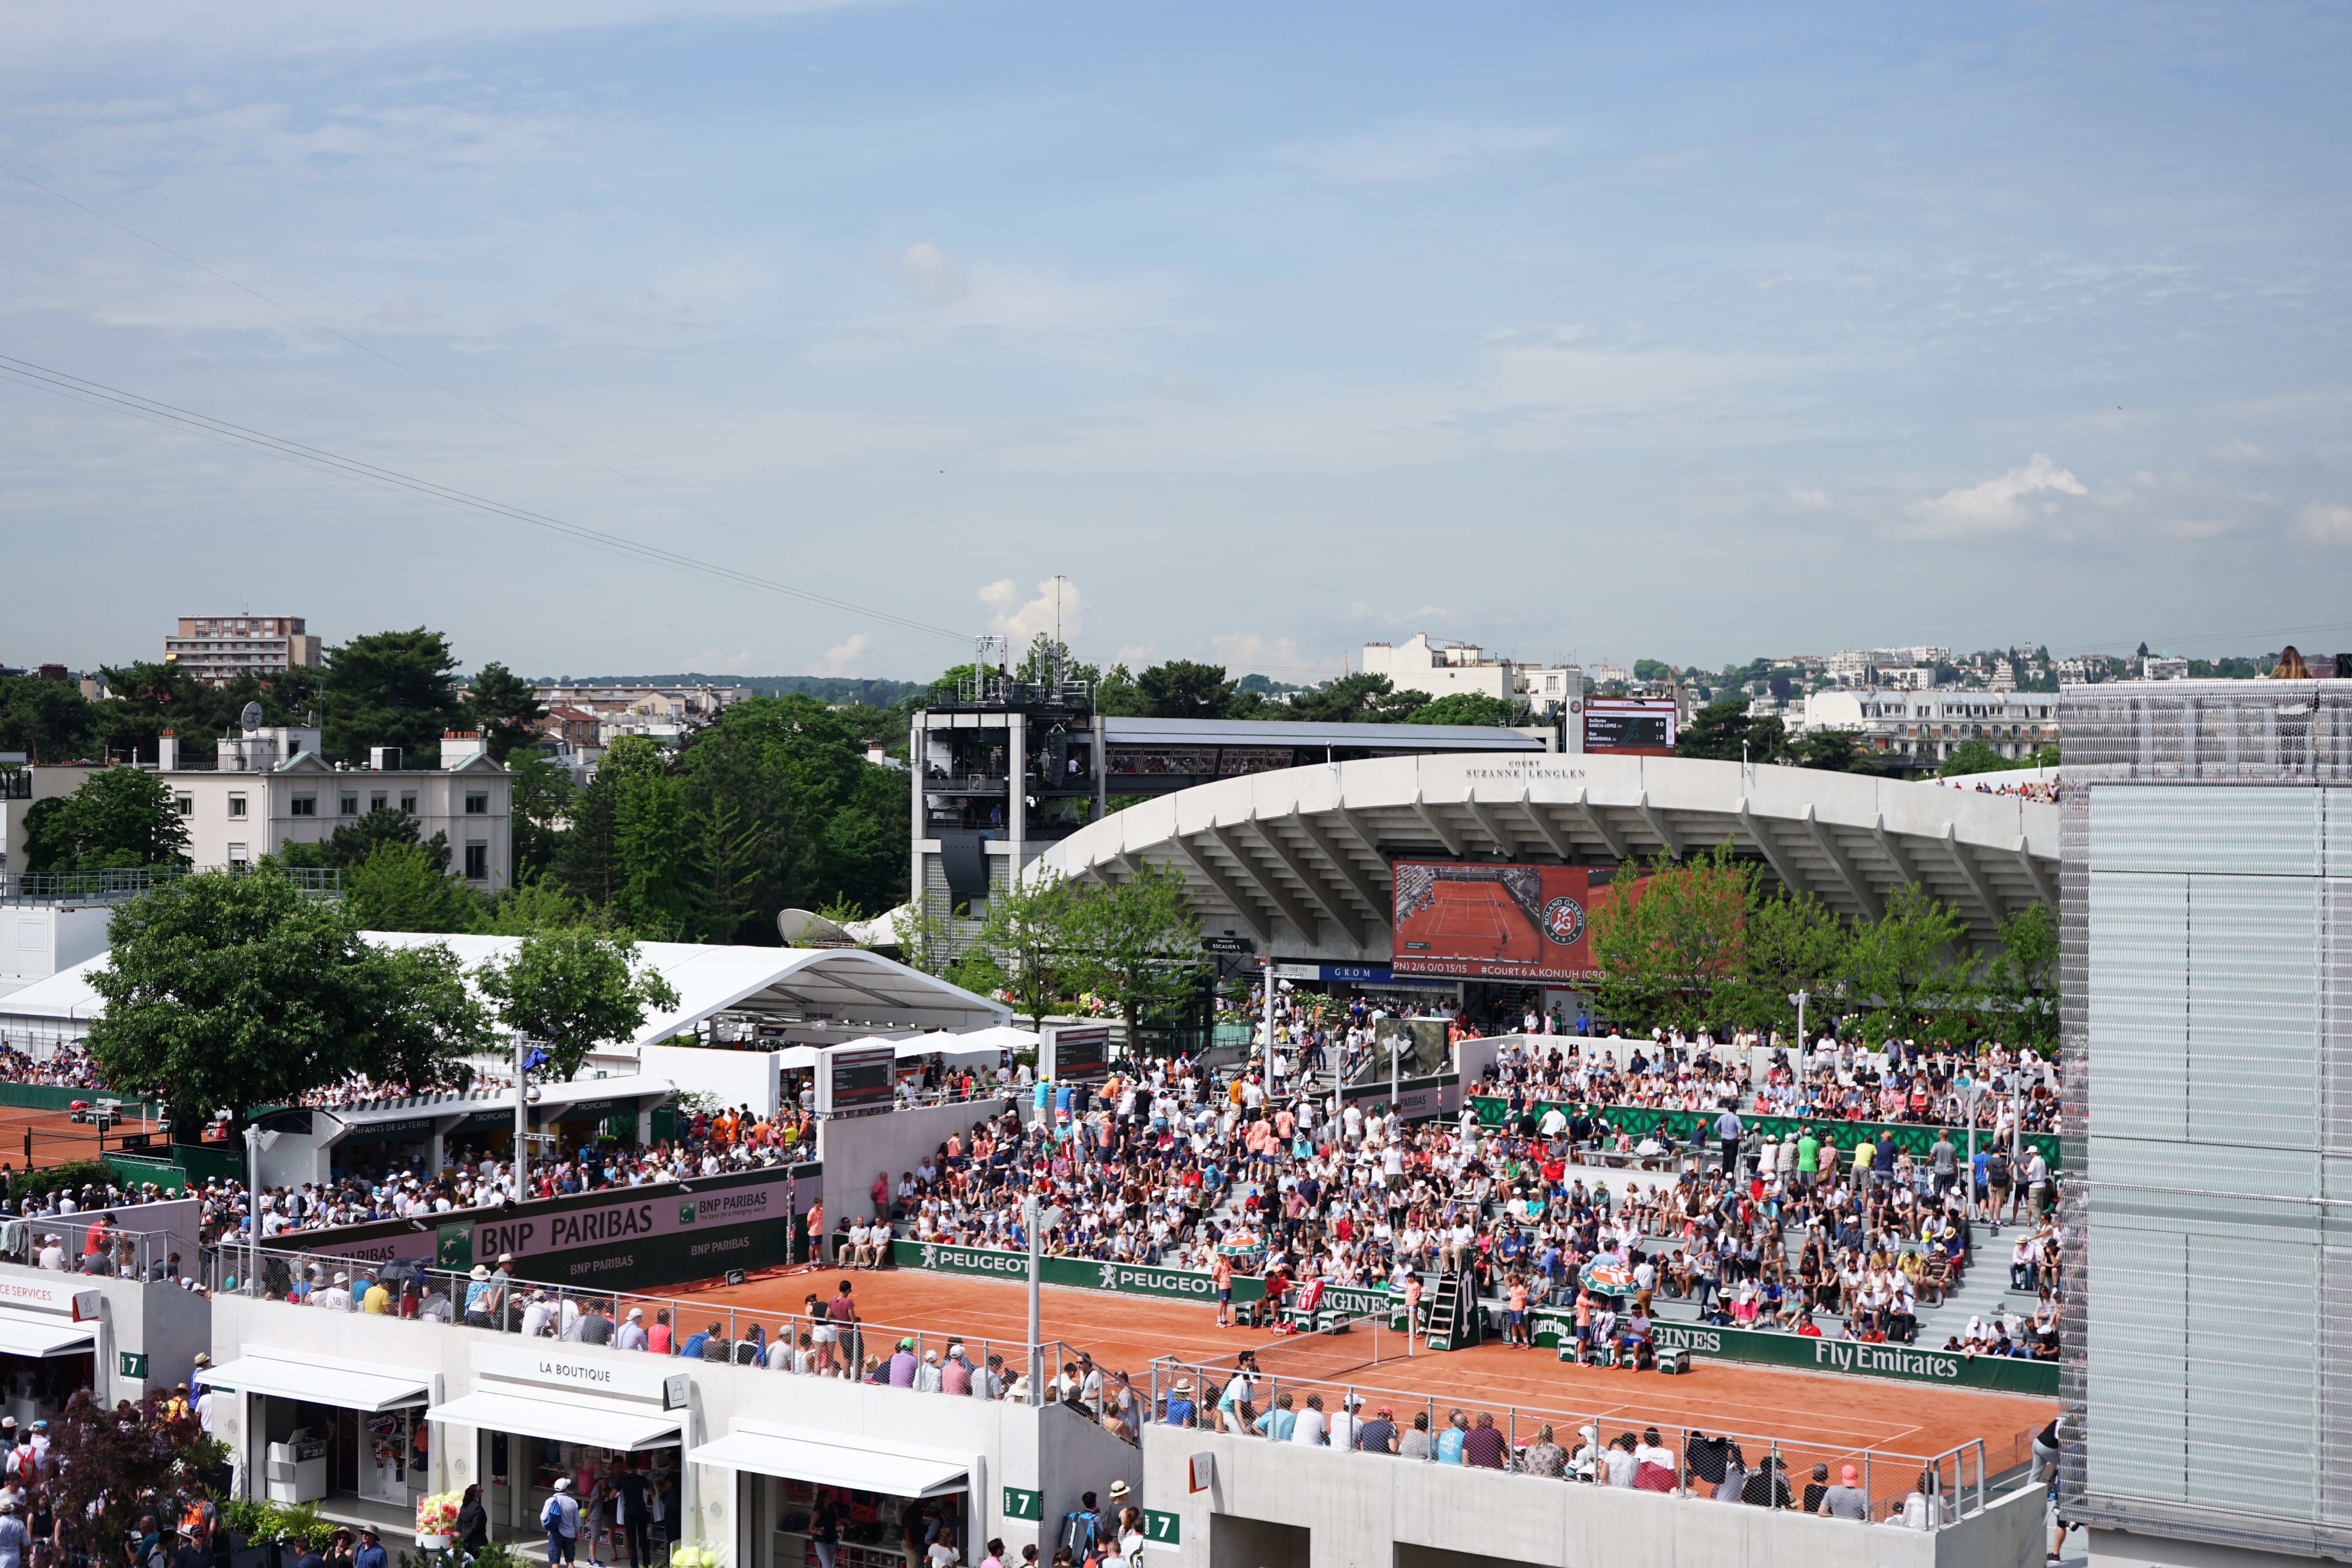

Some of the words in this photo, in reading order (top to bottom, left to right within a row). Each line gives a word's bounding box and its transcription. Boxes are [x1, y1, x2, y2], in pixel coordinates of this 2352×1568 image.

[1466, 769, 1520, 779] SUZANNE
[1529, 769, 1586, 779] LENGLEN
[1544, 899, 1563, 926] ROLAND
[1564, 899, 1583, 927] GARROS
[1550, 932, 1576, 942] PARIS
[1412, 963, 1425, 971] 2/6
[1427, 964, 1444, 972] 0/0
[1446, 964, 1467, 973] 15/15
[1481, 965, 1519, 976] #COURT
[1522, 967, 1527, 976] 6
[1529, 968, 1579, 978] A.KONJUH
[578, 1101, 612, 1111] TROPICANA
[1400, 1095, 1426, 1107] PARIBAS
[102, 1122, 106, 1130] 8
[475, 1112, 511, 1122] TROPICANA
[351, 1124, 384, 1135] ENFANTS
[408, 1120, 430, 1129] TERRE
[699, 1198, 721, 1214] BNP
[724, 1192, 767, 1210] PARIBAS
[482, 1223, 534, 1257] BNP
[551, 1205, 652, 1247] PARIBAS
[341, 1245, 395, 1265] PARIBAS
[691, 1244, 710, 1256] BNP
[712, 1237, 749, 1253] PARIBAS
[570, 1262, 591, 1275] BNP
[593, 1255, 633, 1272] PARIBAS
[1120, 1270, 1218, 1294] PEUGEOT
[12, 1286, 51, 1301] SERVICES
[332, 1296, 341, 1306] 18
[1530, 1317, 1568, 1345] perrier
[1429, 1335, 1447, 1348] perrier
[129, 1357, 137, 1374] 7
[1815, 1340, 1852, 1370] Fly
[1857, 1345, 1958, 1377] Emirates
[540, 1361, 552, 1374] LA
[556, 1365, 610, 1382] BOUTIQUE
[1018, 1494, 1030, 1515] 7
[1158, 1516, 1171, 1538] 7
